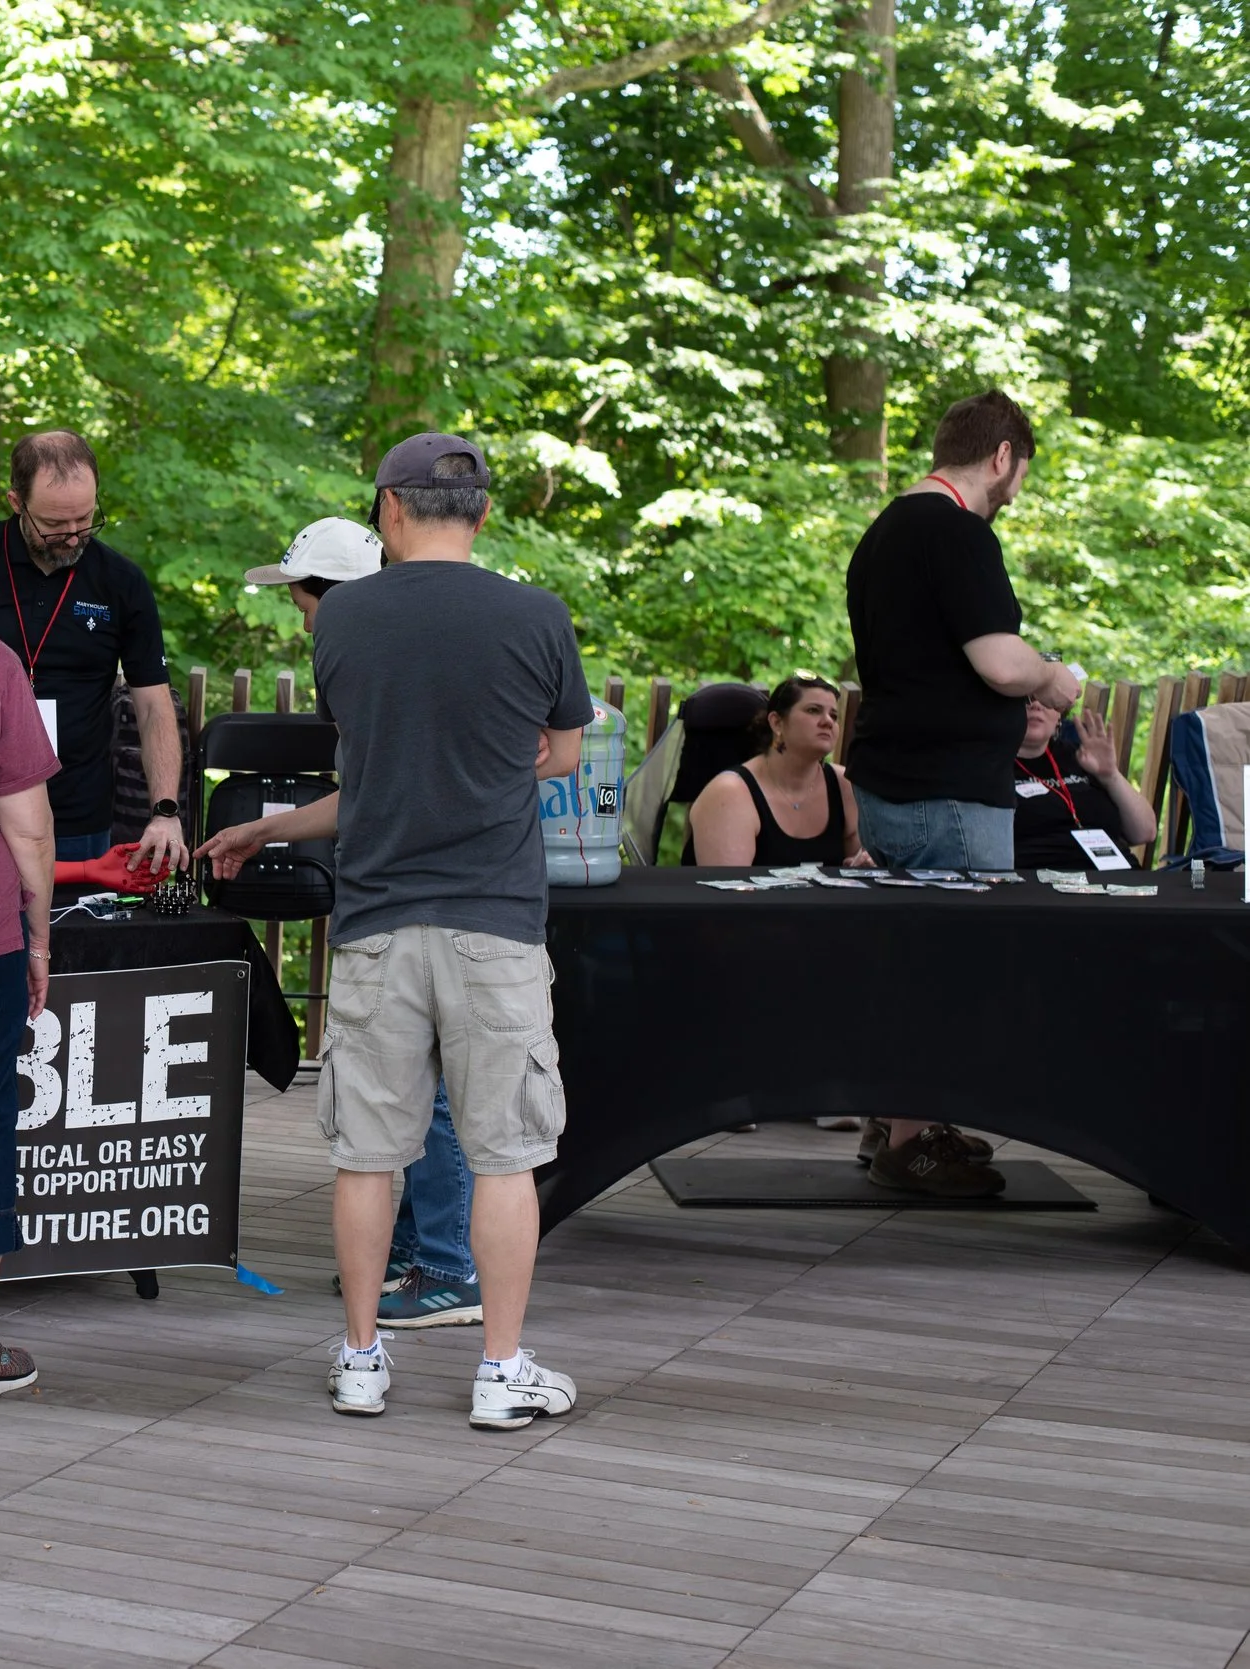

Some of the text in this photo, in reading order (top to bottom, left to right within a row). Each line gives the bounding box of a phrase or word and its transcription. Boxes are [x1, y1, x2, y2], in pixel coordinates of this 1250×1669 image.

[74, 605, 110, 621] SAINTS
[76, 601, 109, 611] MARYMOUNT
[16, 1144, 89, 1169] TICAL
[99, 1139, 132, 1164] OR
[140, 1133, 207, 1161] EASY
[33, 1162, 207, 1196] OPPORTUNITY
